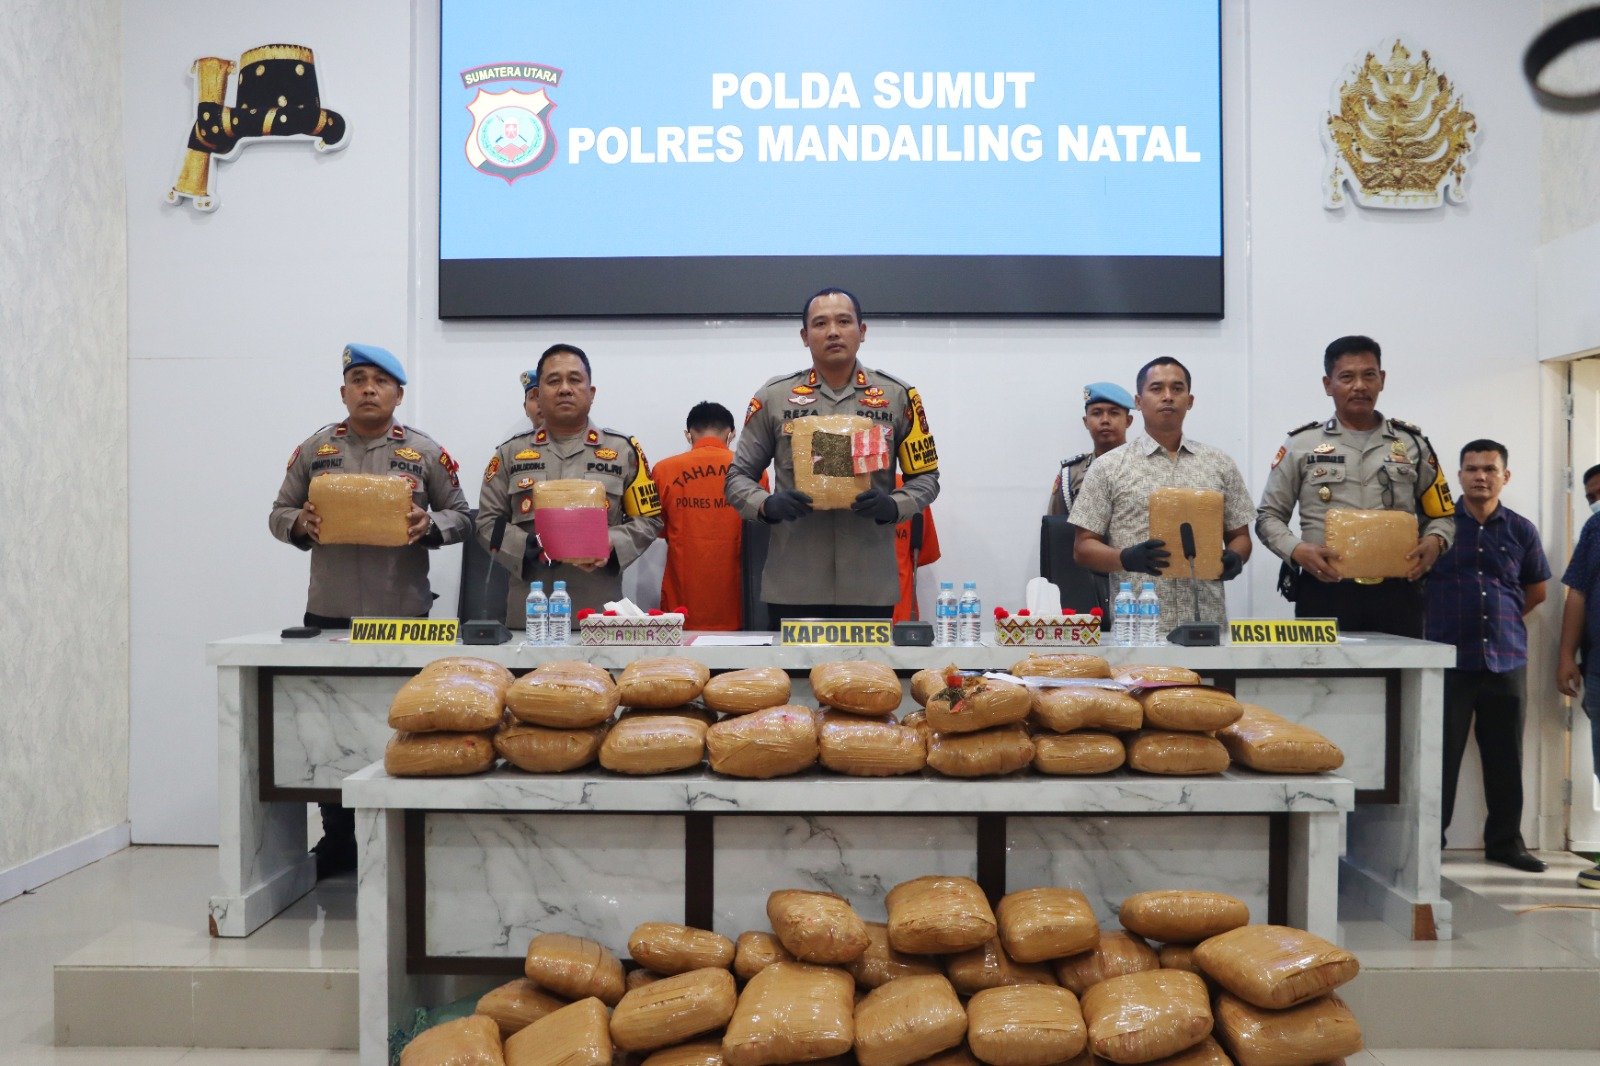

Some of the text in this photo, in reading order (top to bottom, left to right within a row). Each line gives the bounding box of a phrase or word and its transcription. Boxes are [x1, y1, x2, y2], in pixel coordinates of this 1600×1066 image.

[465, 67, 557, 84] SUMATERA UTARA
[711, 71, 1035, 109] POLDA SUMUT
[568, 124, 1201, 164] POLRES MANDAILING NATAL
[783, 409, 819, 419] REZA
[390, 460, 423, 474] POLRI
[587, 463, 622, 475] POLRI
[676, 497, 711, 509] POLRES
[352, 622, 456, 641] WAKA POLRES
[782, 625, 890, 644] KAPOLRES
[1231, 624, 1337, 643] KASI HUMAS
